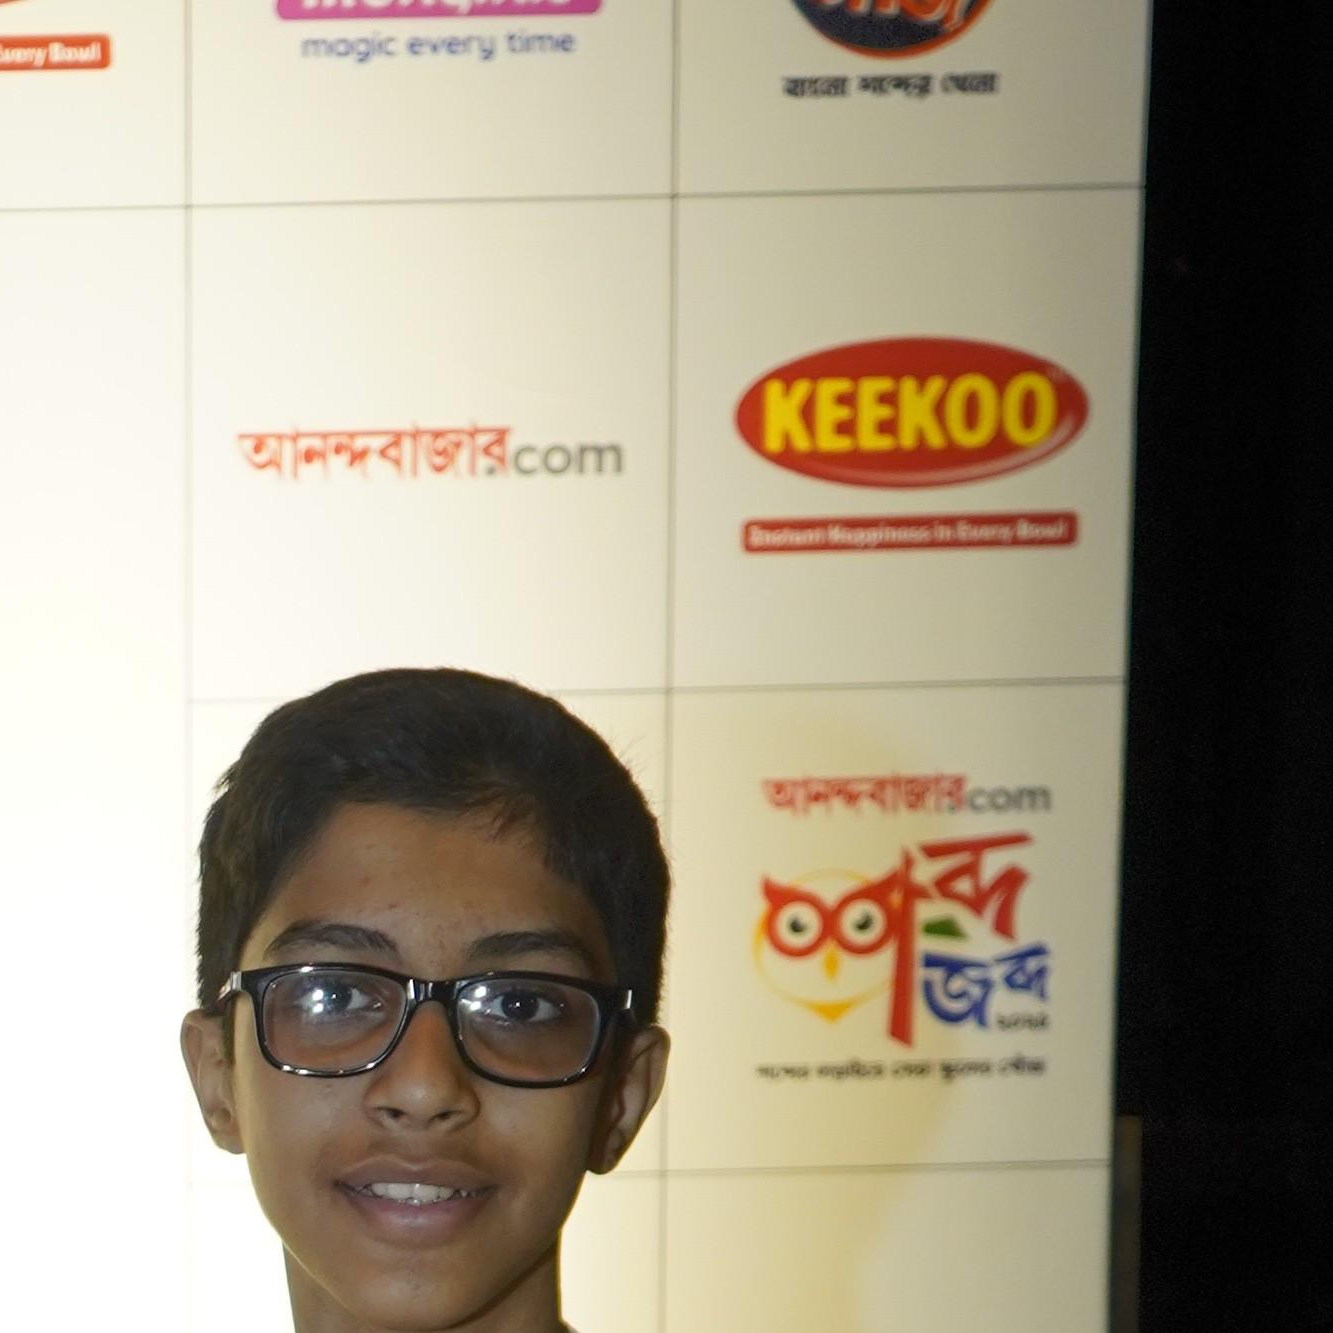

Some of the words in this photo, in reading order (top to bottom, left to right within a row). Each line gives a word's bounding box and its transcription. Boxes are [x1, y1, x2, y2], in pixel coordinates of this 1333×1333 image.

[302, 30, 396, 62] magic
[407, 29, 498, 62] every
[507, 27, 576, 55] time
[763, 371, 1057, 454] KEEKOO
